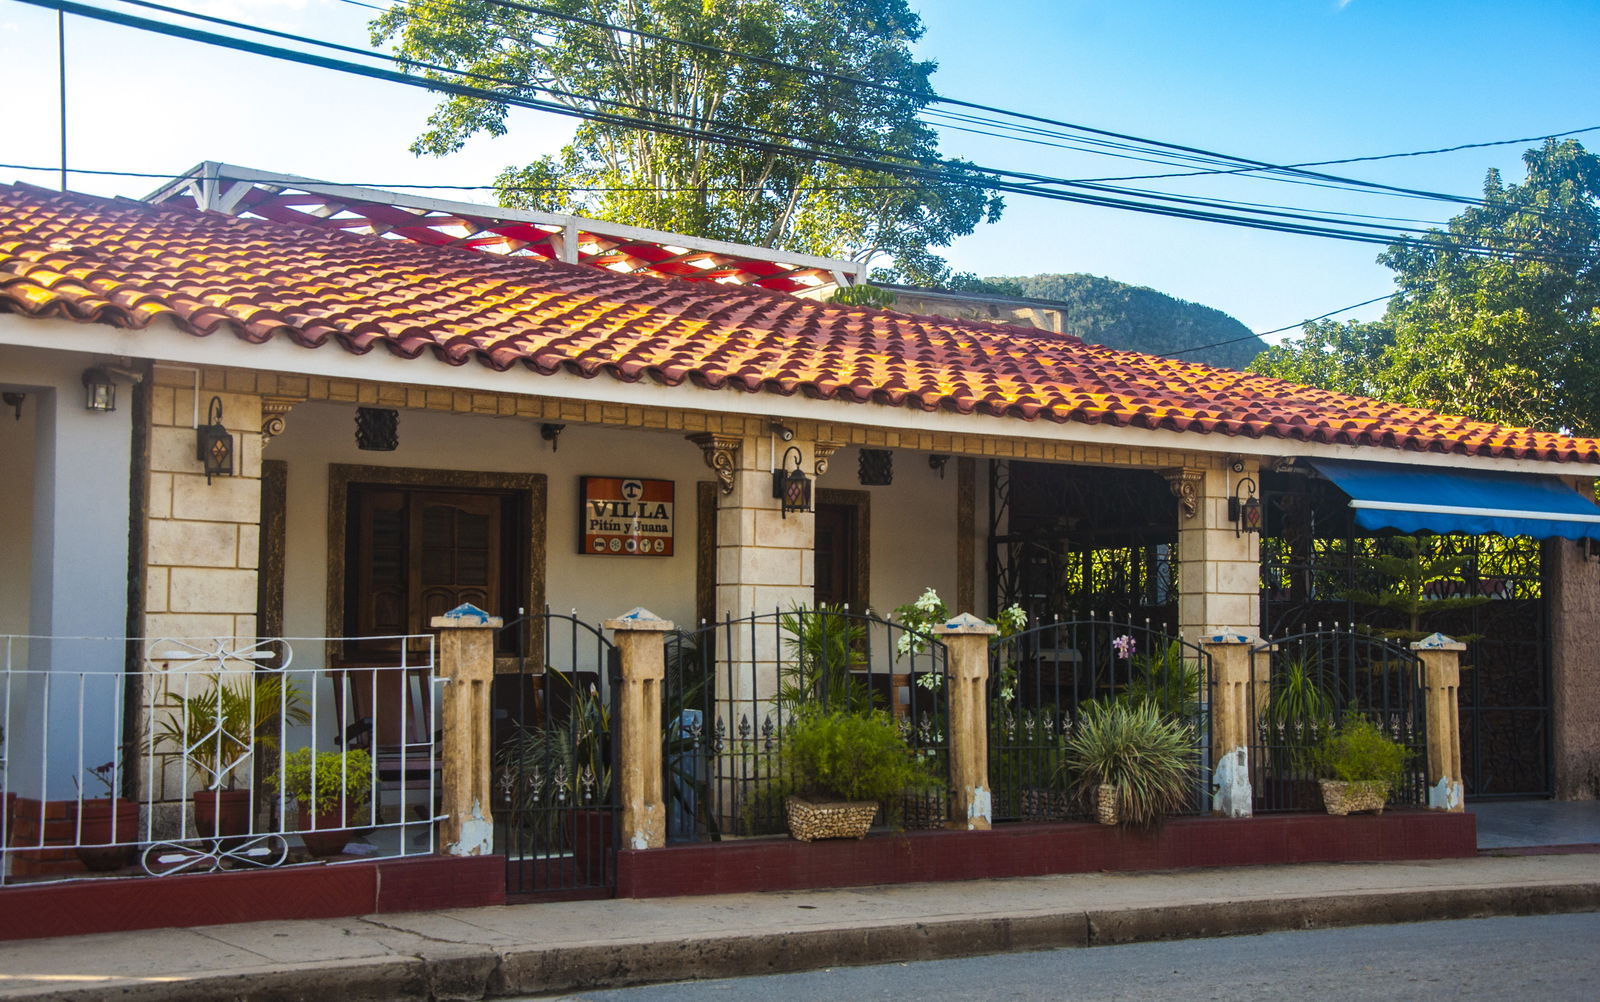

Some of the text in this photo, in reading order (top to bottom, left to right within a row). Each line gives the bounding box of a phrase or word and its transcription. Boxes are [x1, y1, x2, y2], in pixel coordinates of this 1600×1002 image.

[591, 500, 669, 519] VILLA
[590, 519, 668, 534] Pitín y Juana
